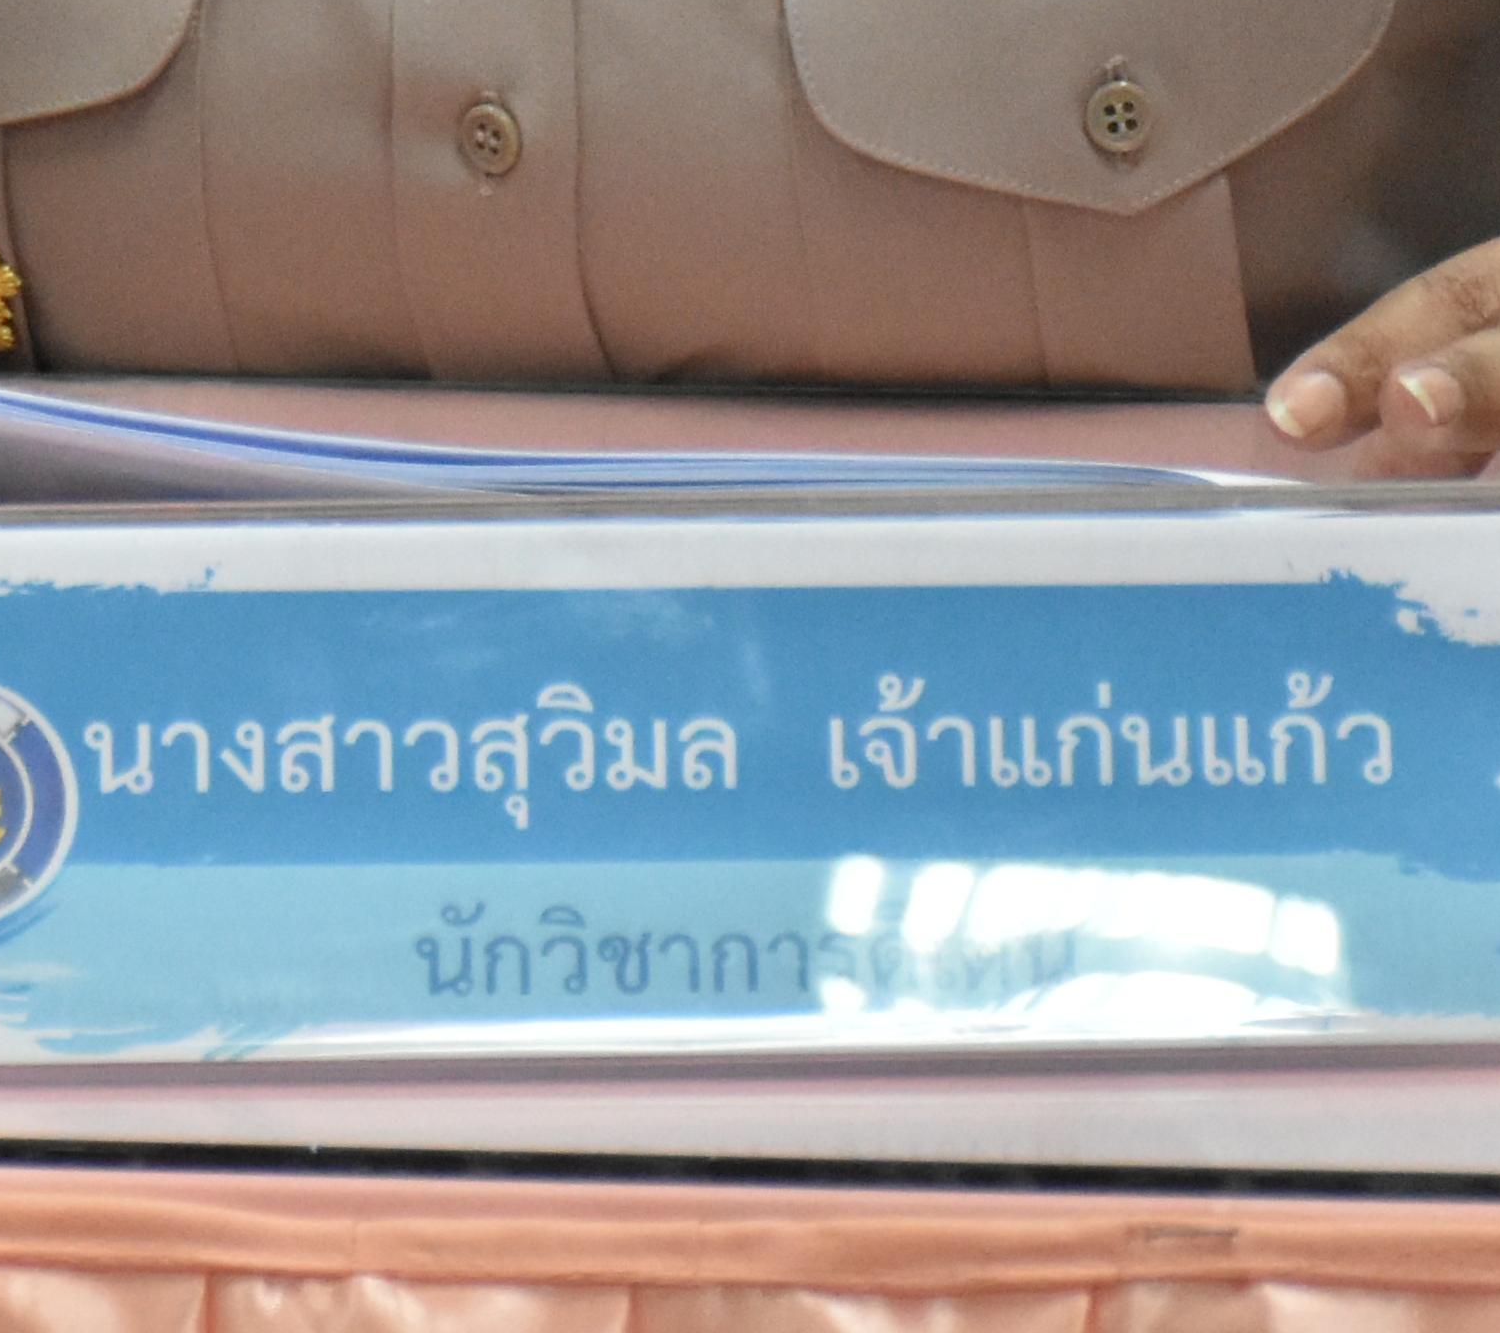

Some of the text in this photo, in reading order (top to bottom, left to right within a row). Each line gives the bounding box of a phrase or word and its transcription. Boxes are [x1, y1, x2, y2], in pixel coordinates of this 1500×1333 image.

[84, 672, 1395, 830] นางสาวสุวิมล เจ้าแก่นแก้ว
